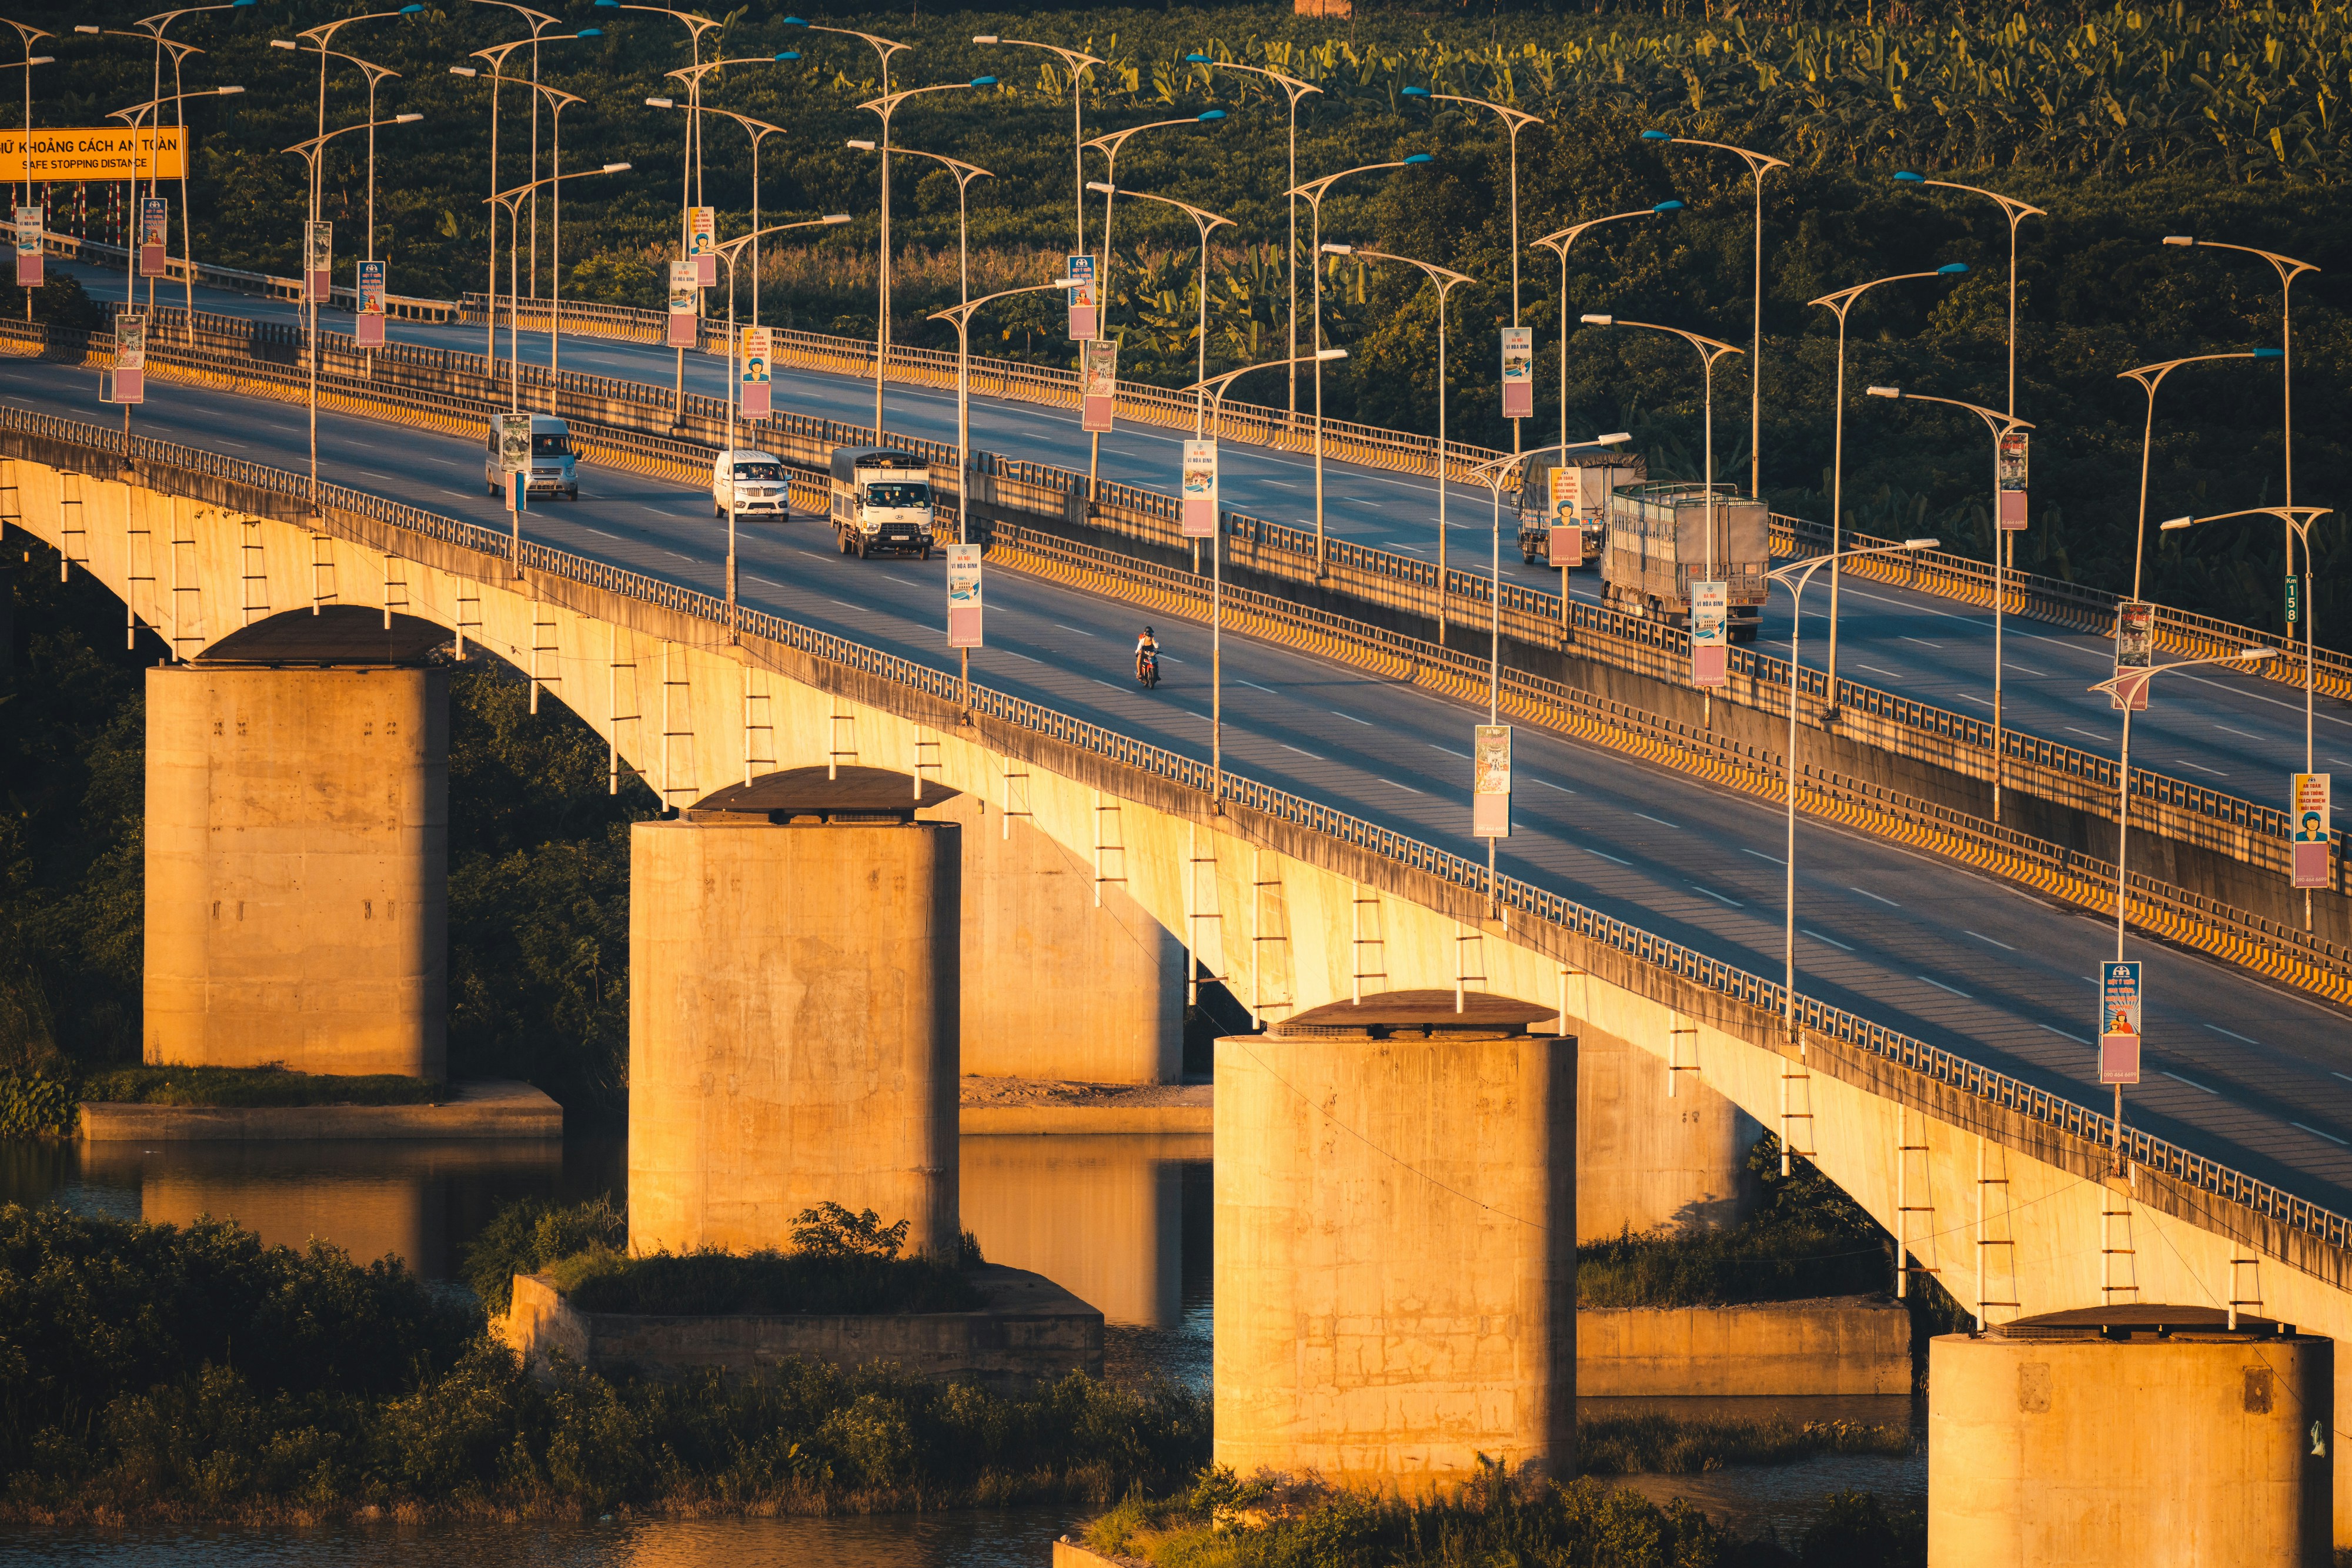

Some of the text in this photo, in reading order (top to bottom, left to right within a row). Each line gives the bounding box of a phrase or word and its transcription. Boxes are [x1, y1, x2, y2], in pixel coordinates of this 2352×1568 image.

[0, 140, 14, 153] IỮ
[19, 138, 74, 153] KHOẢNG
[79, 138, 113, 152] CÁCH
[119, 140, 136, 151] AN
[22, 159, 146, 169] SAFE STOPPING DISTANCE
